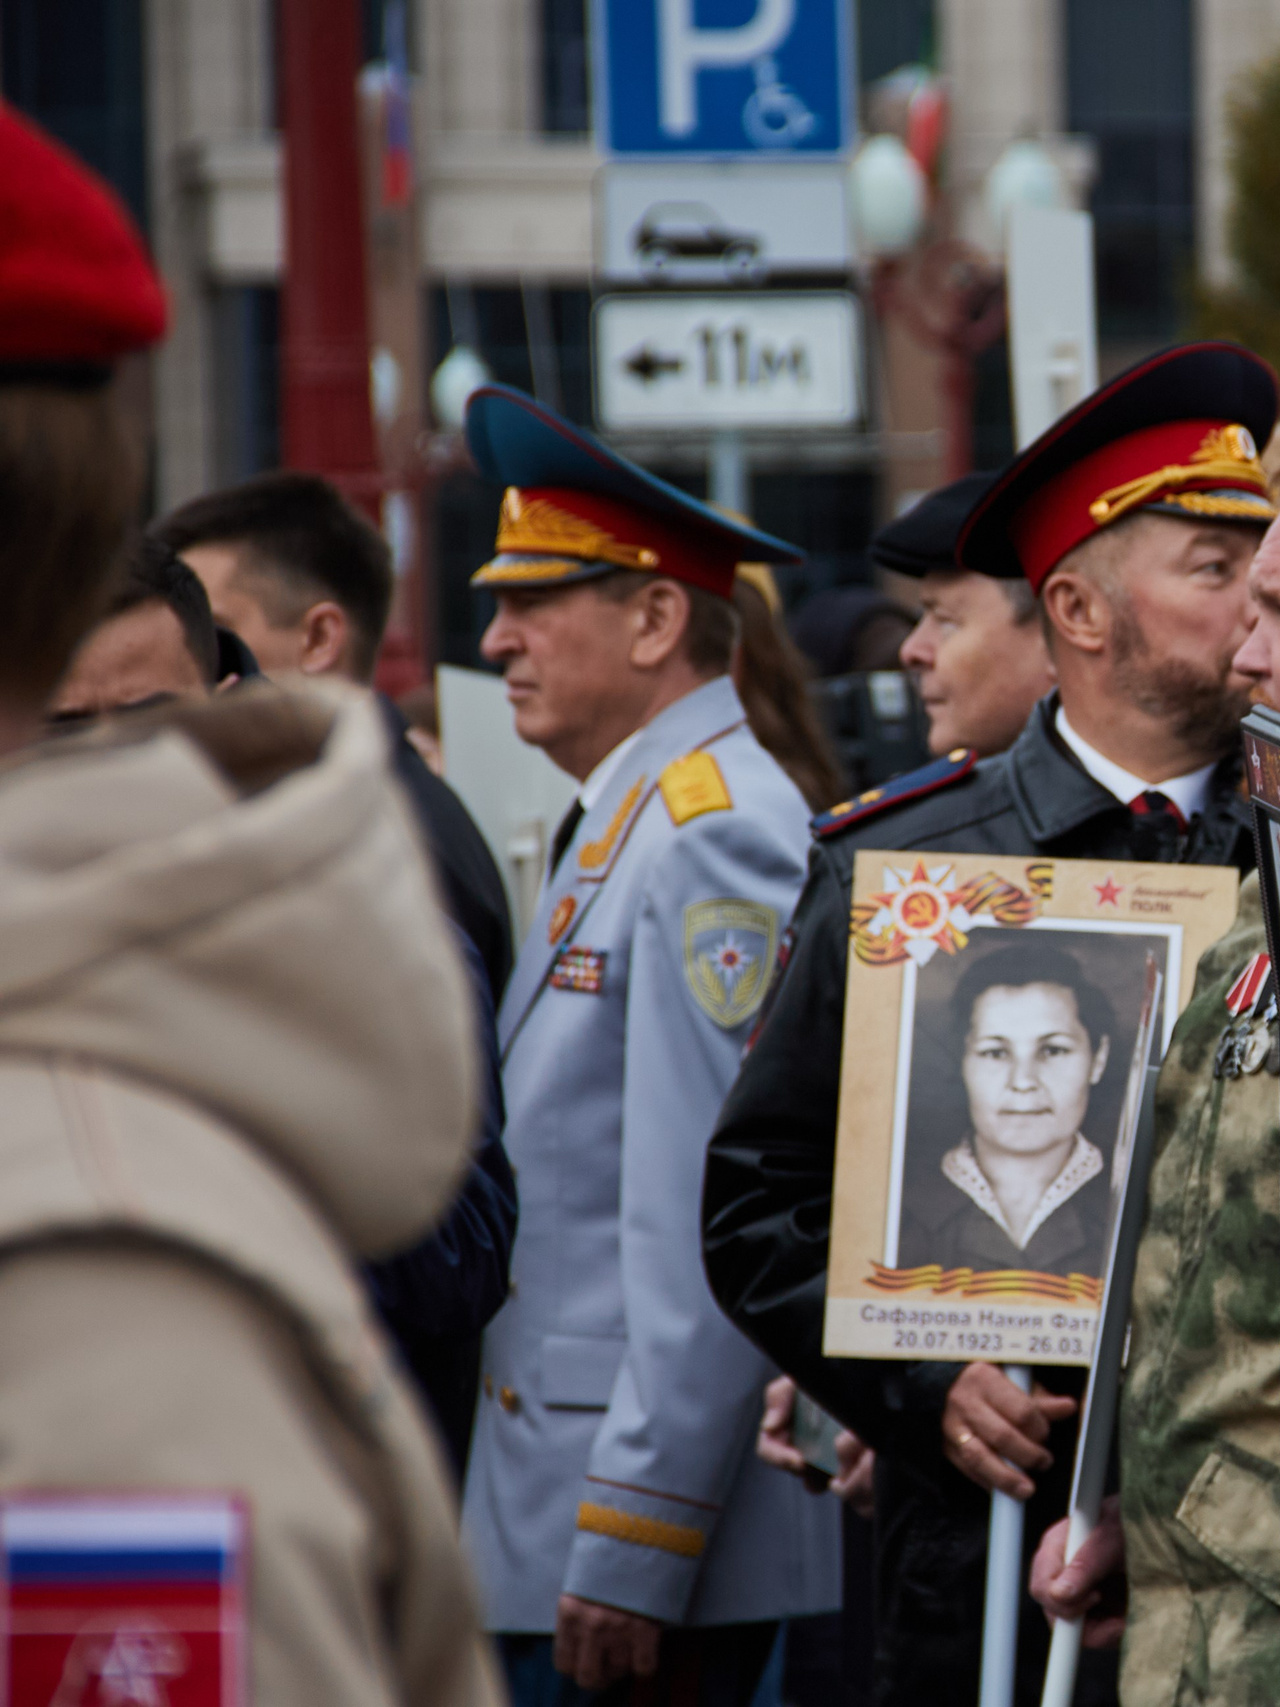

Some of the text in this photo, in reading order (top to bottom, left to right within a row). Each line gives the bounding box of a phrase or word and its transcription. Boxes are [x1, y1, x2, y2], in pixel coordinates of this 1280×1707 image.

[656, 0, 796, 136] P
[860, 1304, 1099, 1334] Сафарова Накия Фат
[894, 1330, 1002, 1351] 20.07.1923
